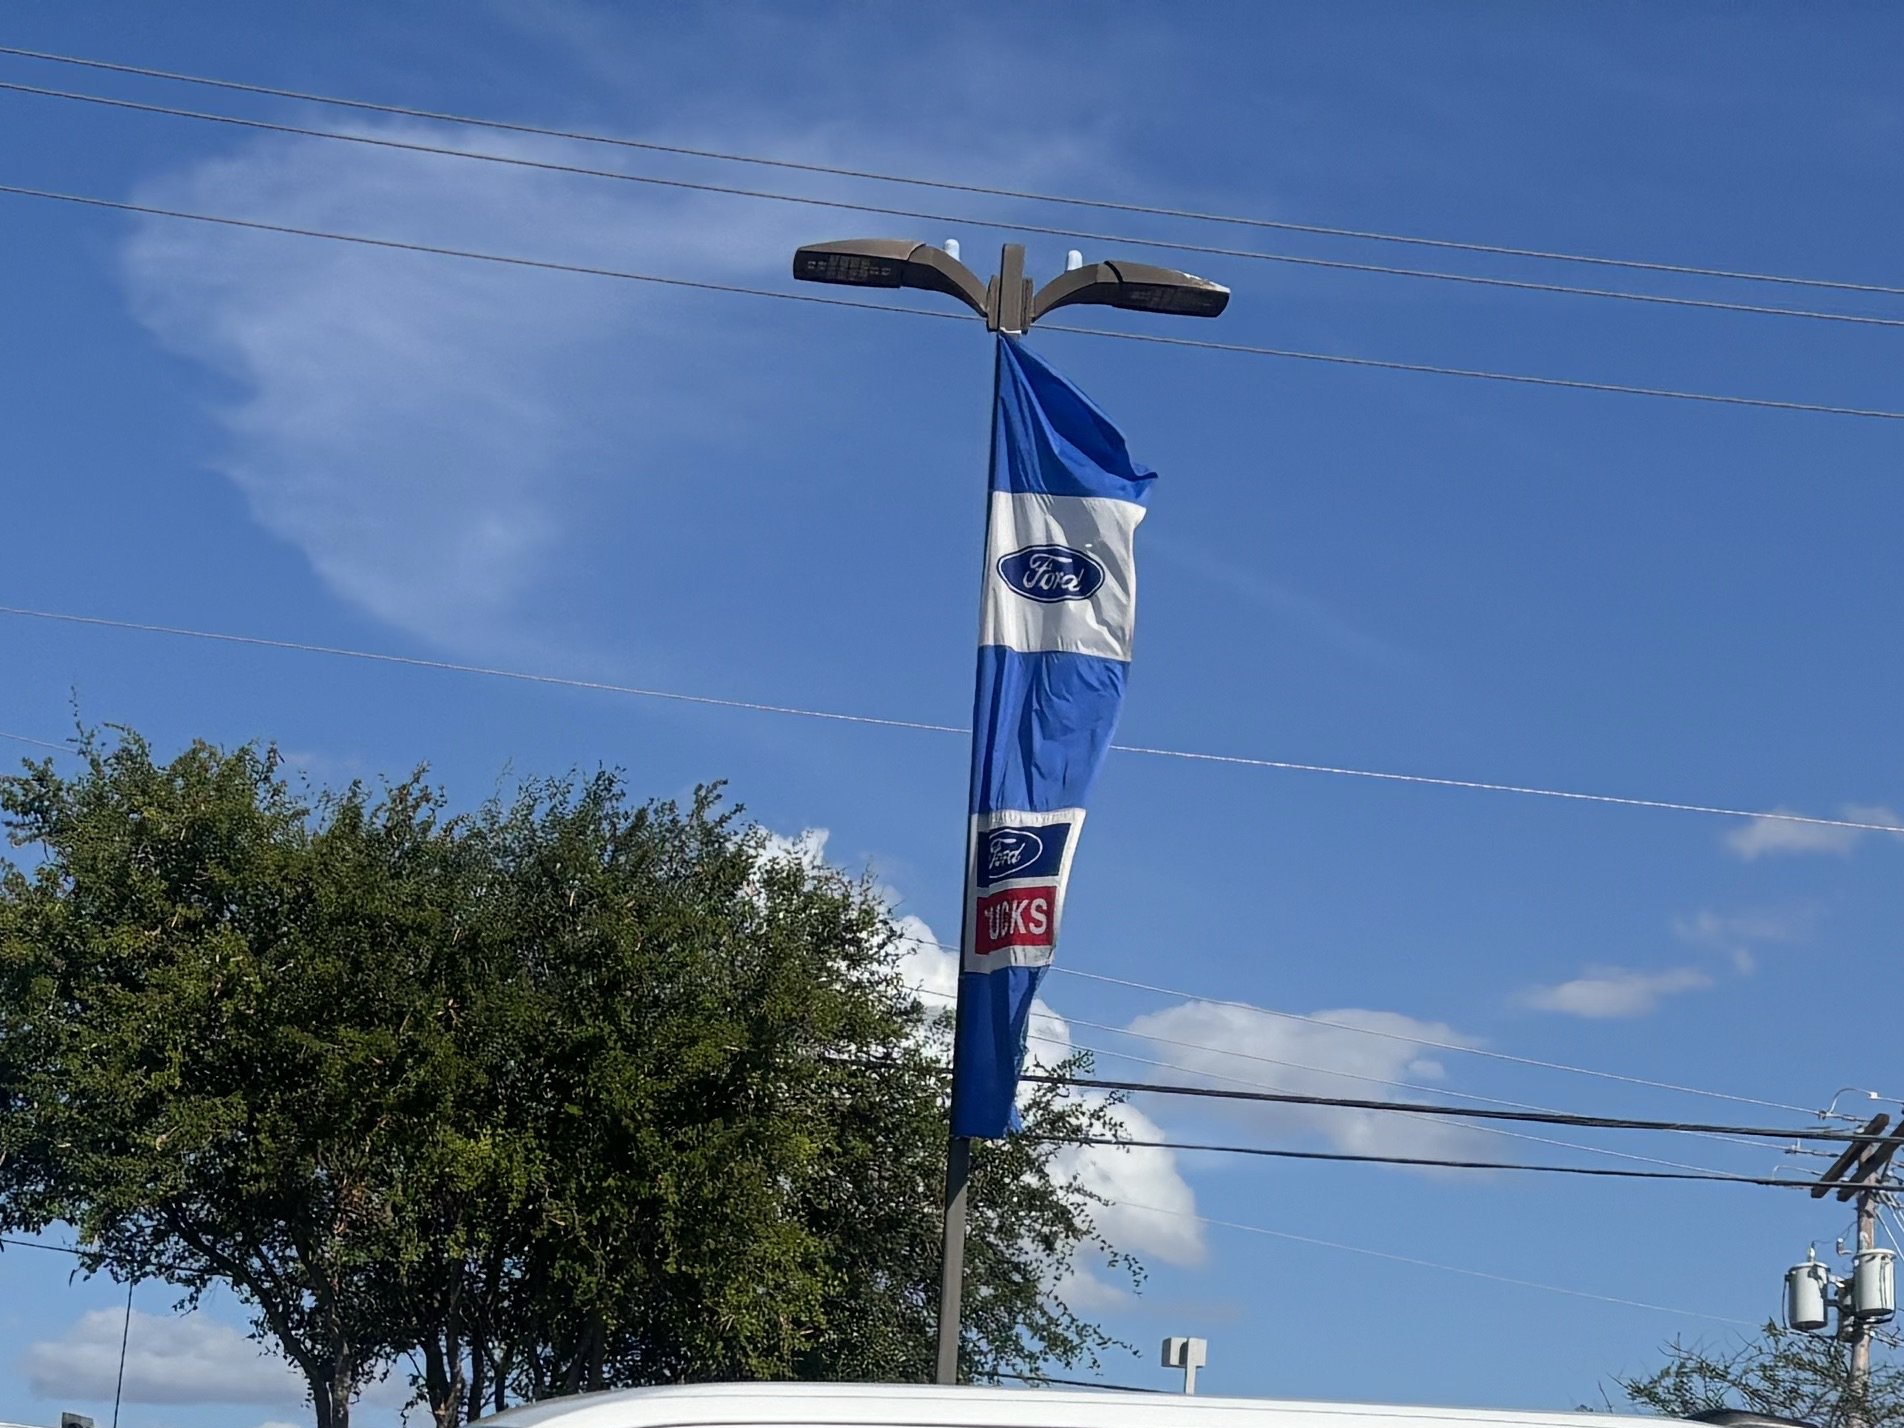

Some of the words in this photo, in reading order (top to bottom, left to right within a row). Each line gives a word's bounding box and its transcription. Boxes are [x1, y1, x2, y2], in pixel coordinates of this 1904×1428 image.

[1022, 553, 1085, 592] Ford
[988, 838, 1026, 870] Ford
[984, 897, 1048, 940] UCKS
